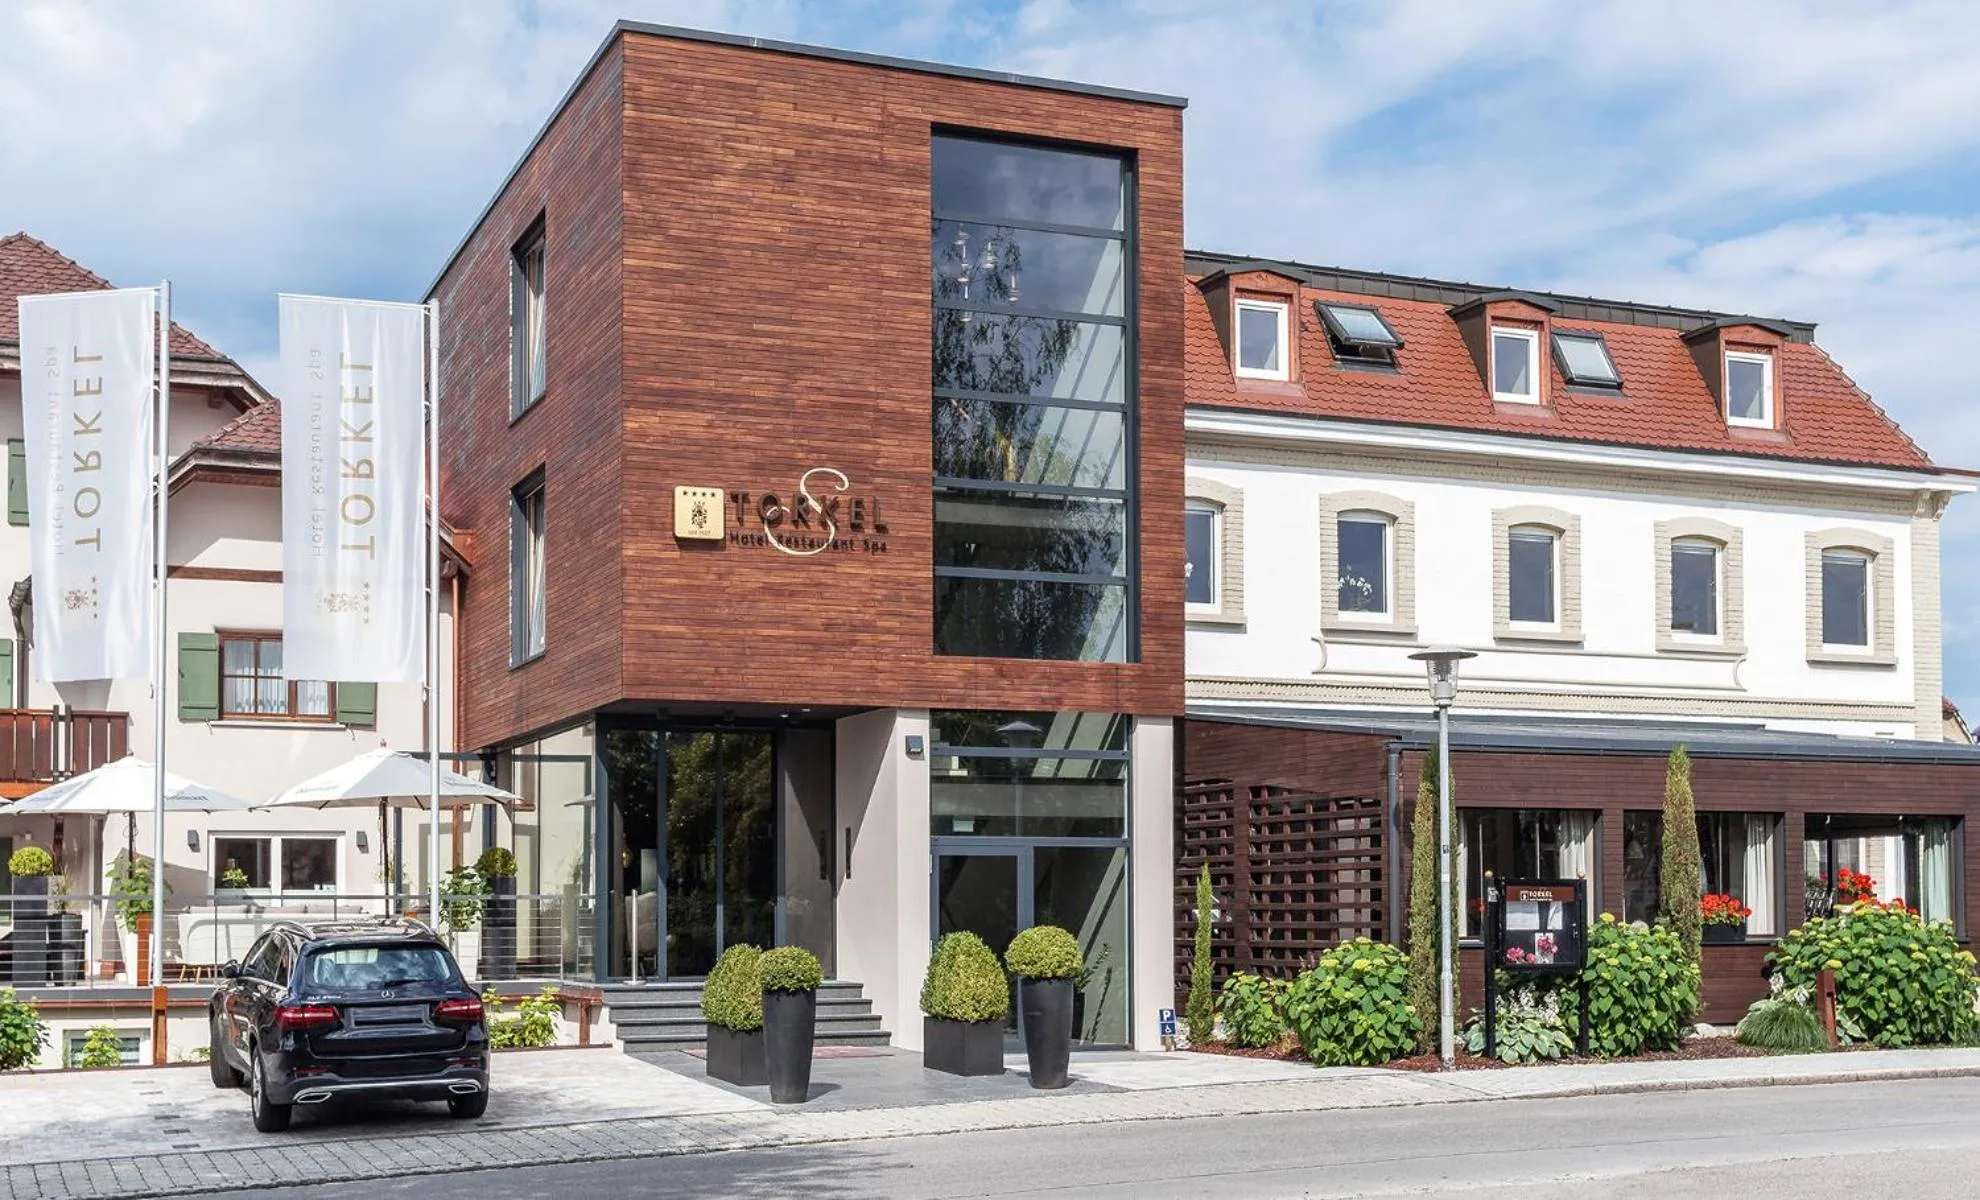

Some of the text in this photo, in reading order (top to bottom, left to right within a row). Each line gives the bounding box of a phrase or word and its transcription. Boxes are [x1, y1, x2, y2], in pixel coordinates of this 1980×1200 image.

[730, 490, 886, 529] TORKEL
[729, 530, 769, 547] Hotel
[864, 537, 887, 555] Spa
[1163, 1010, 1171, 1021] P
